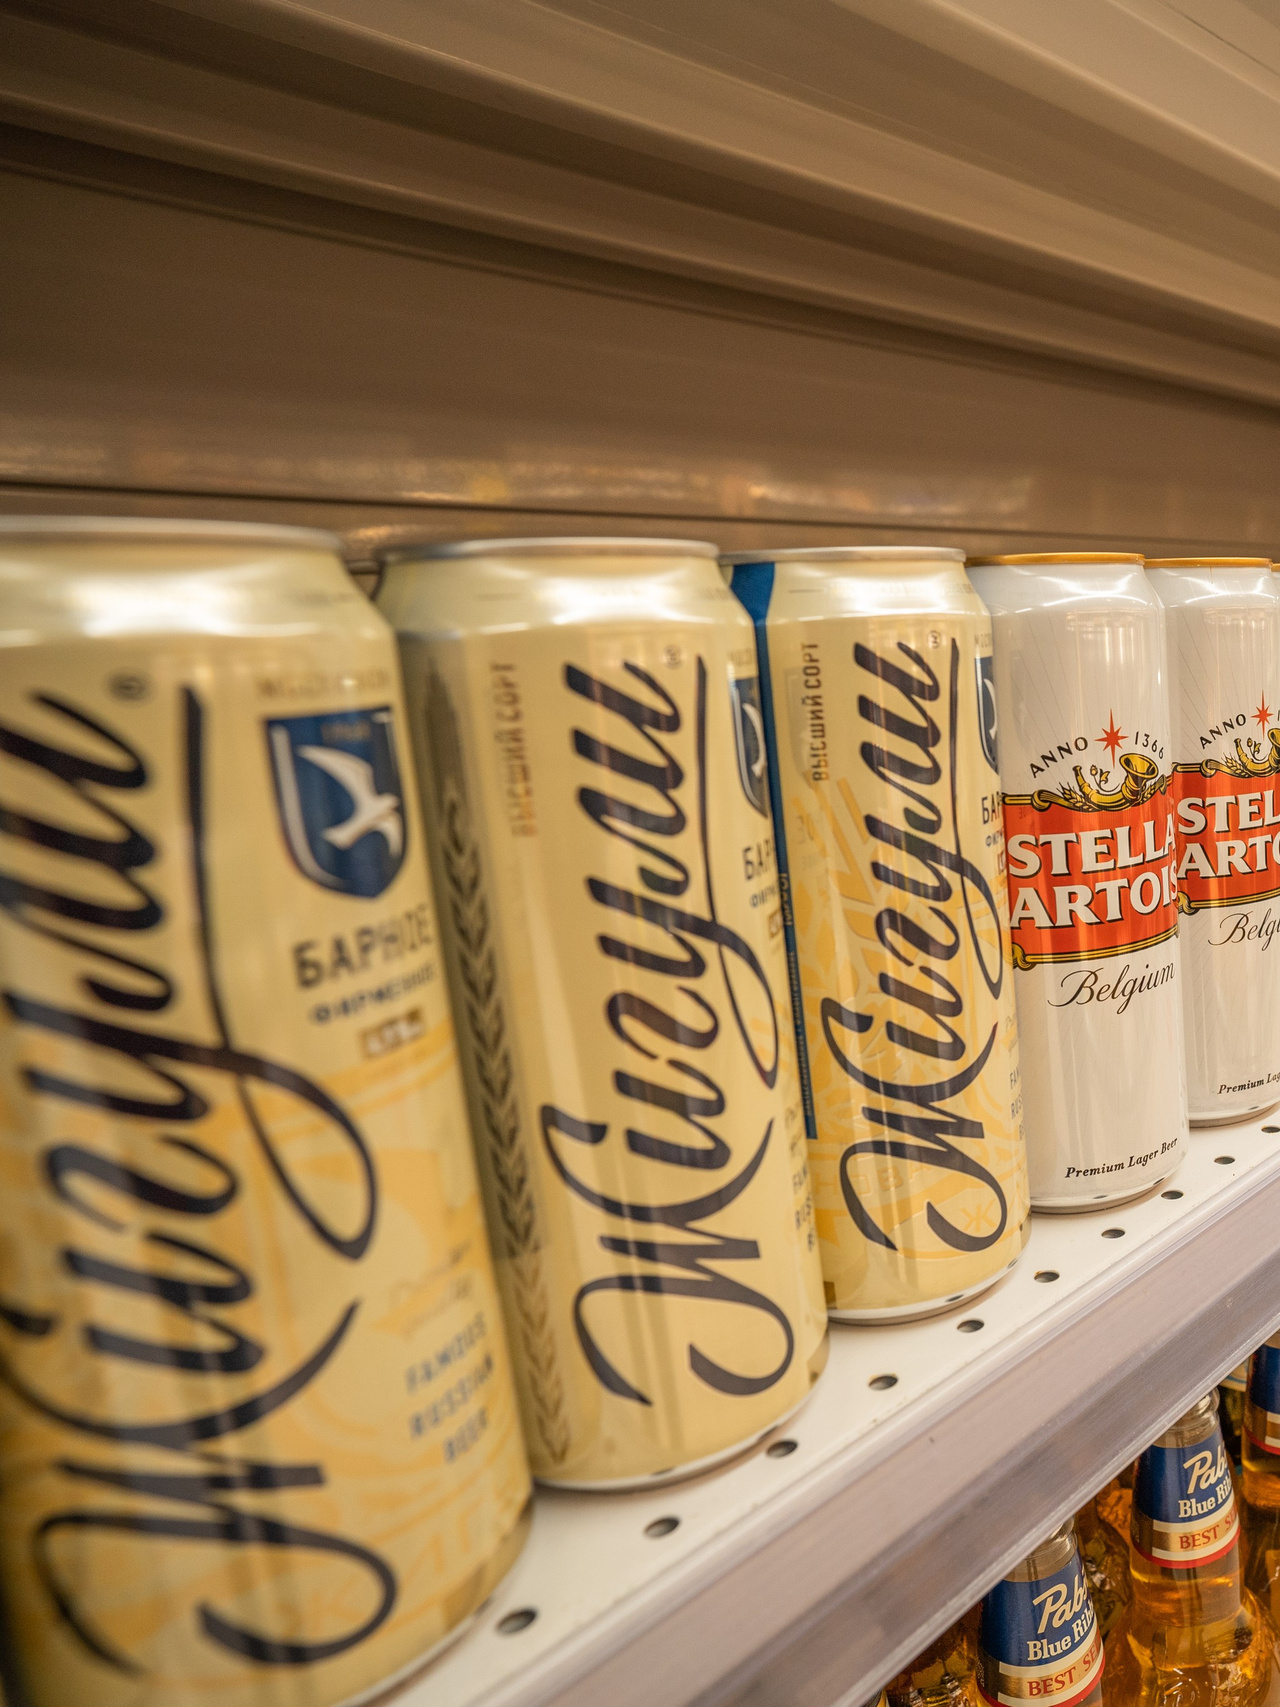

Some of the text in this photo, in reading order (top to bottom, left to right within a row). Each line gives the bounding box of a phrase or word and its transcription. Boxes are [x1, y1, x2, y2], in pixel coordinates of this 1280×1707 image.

[800, 642, 831, 783] ВЫСШИЙ СОРТ
[1198, 713, 1247, 751] ANNO
[1029, 730, 1165, 779] ANNO 1366
[1006, 812, 1177, 879] STELLA
[1010, 861, 1179, 930] ARTOIS
[820, 637, 1010, 1252] Жигули
[1046, 962, 1176, 1015] Belgium
[541, 654, 795, 1406] Жигули
[1217, 1078, 1264, 1095] Premium
[1064, 1137, 1178, 1179] Premium Lager Beer
[1177, 1496, 1217, 1518] Blue
[1178, 1524, 1220, 1550] BEST
[1026, 1635, 1072, 1661] Blue
[1026, 1665, 1077, 1697] BEST
